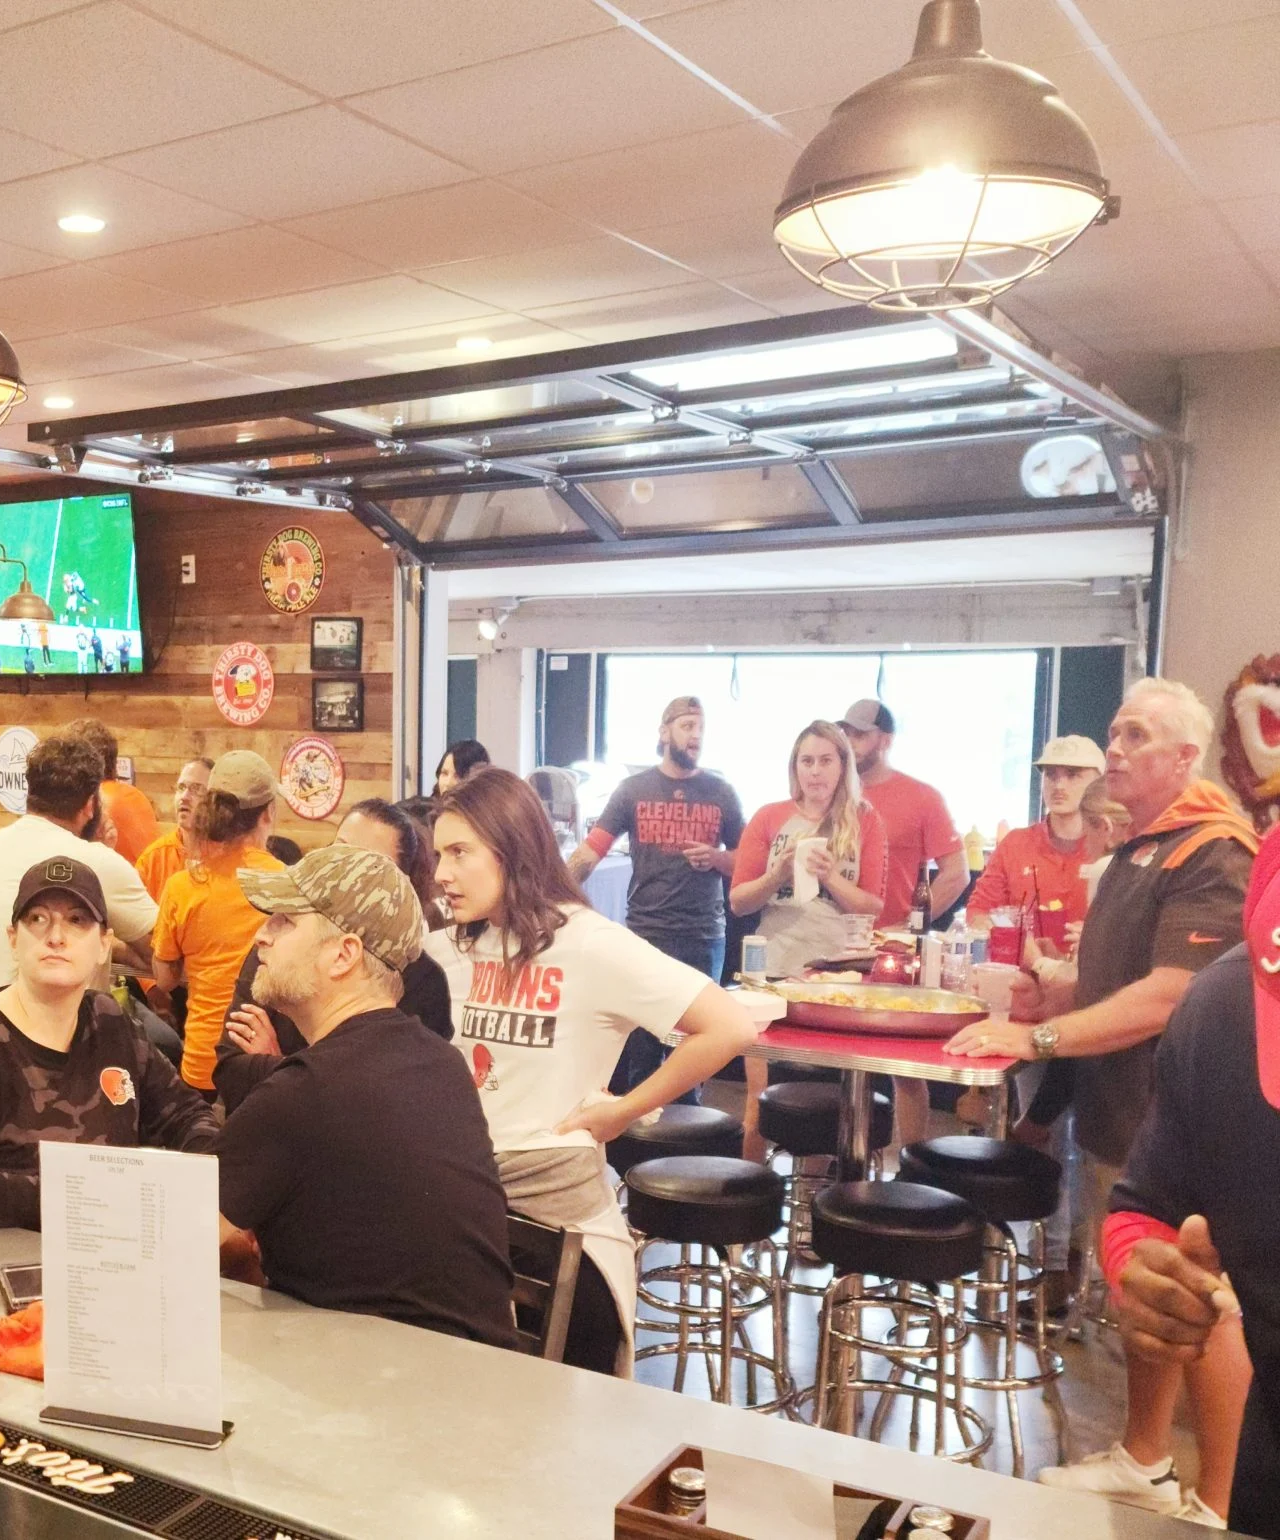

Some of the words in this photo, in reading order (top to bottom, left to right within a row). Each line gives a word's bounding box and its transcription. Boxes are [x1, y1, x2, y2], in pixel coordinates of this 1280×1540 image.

[293, 529, 322, 560] BREWING
[216, 645, 255, 680] THIRSTY
[255, 651, 271, 680] DOG
[216, 686, 260, 722] BREWING
[637, 801, 722, 824] CLEVELAND
[639, 821, 720, 845] BROWNS
[467, 961, 563, 1012] ROWNS
[463, 1007, 550, 1046] OTBALL
[0, 1438, 135, 1495] Tito's
